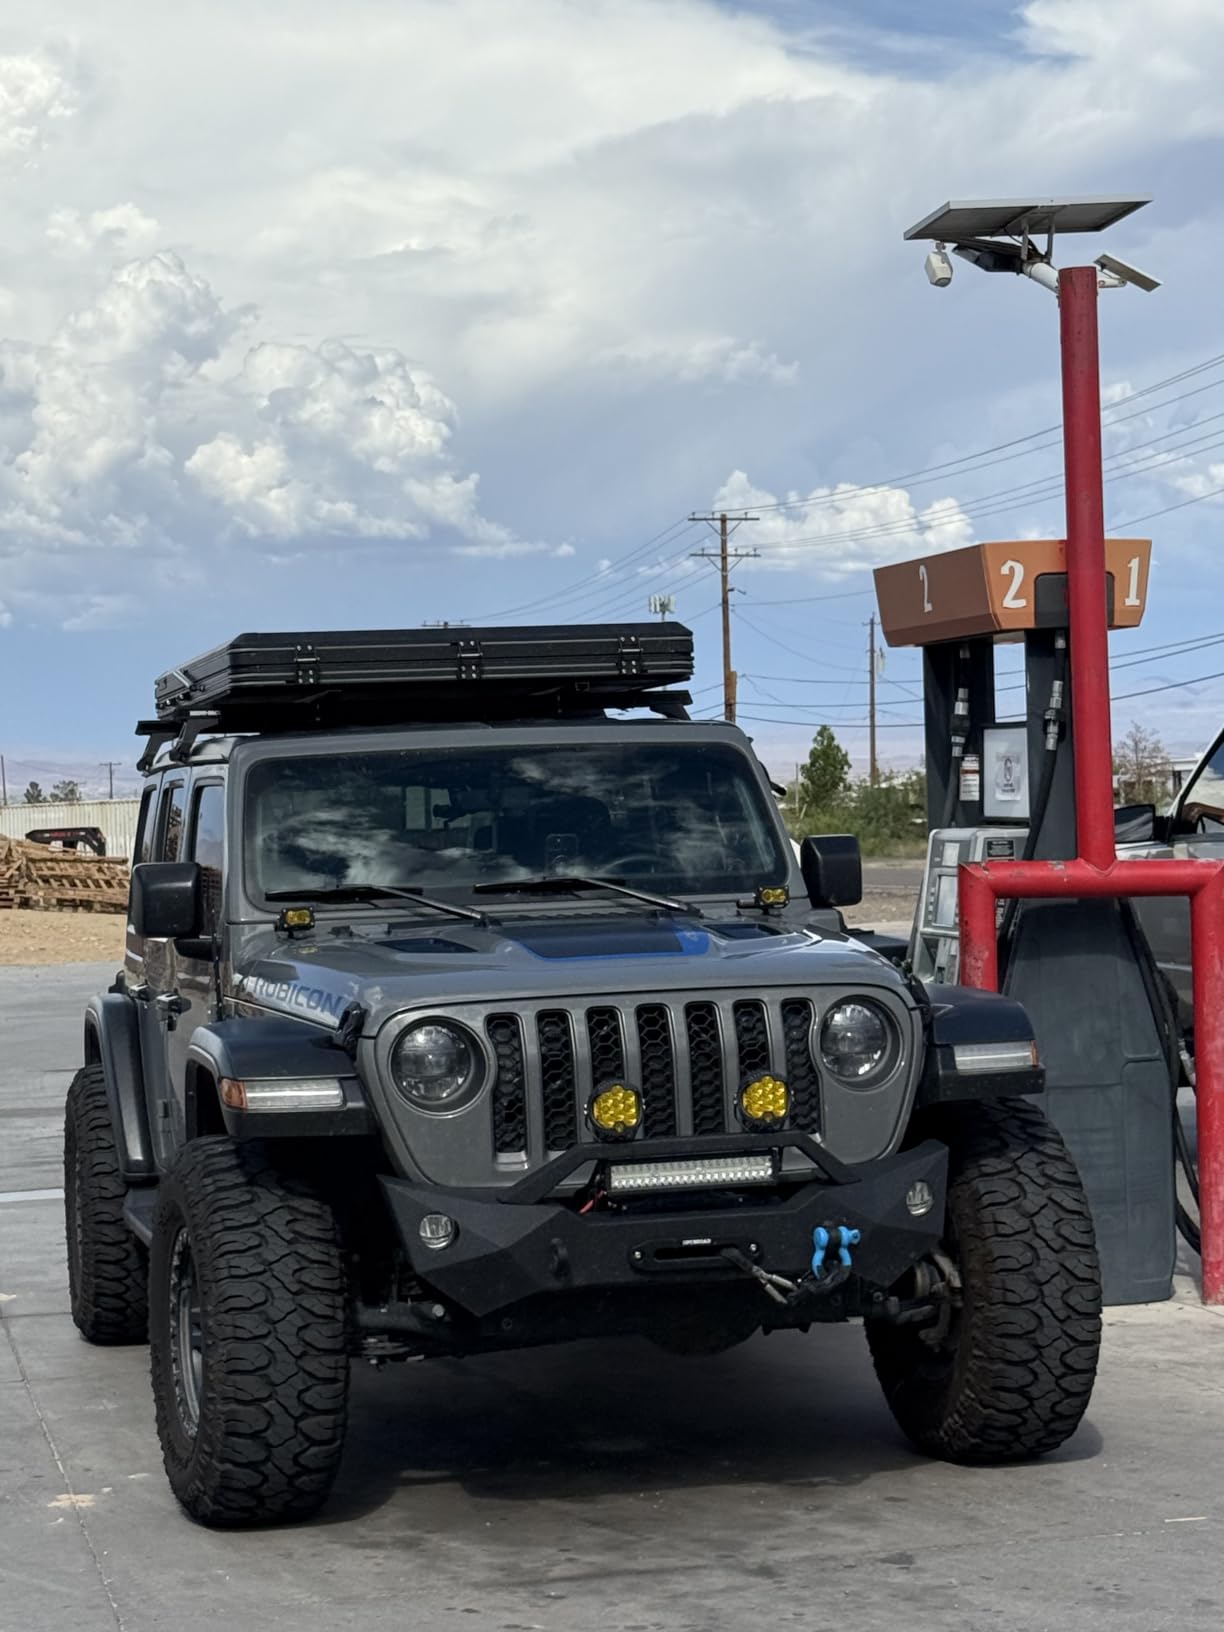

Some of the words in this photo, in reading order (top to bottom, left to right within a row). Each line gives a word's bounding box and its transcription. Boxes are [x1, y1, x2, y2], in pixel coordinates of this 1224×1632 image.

[919, 564, 933, 613] 2
[1000, 559, 1027, 609] 2
[1124, 556, 1141, 607] 1
[253, 976, 342, 1015] RUBICON
